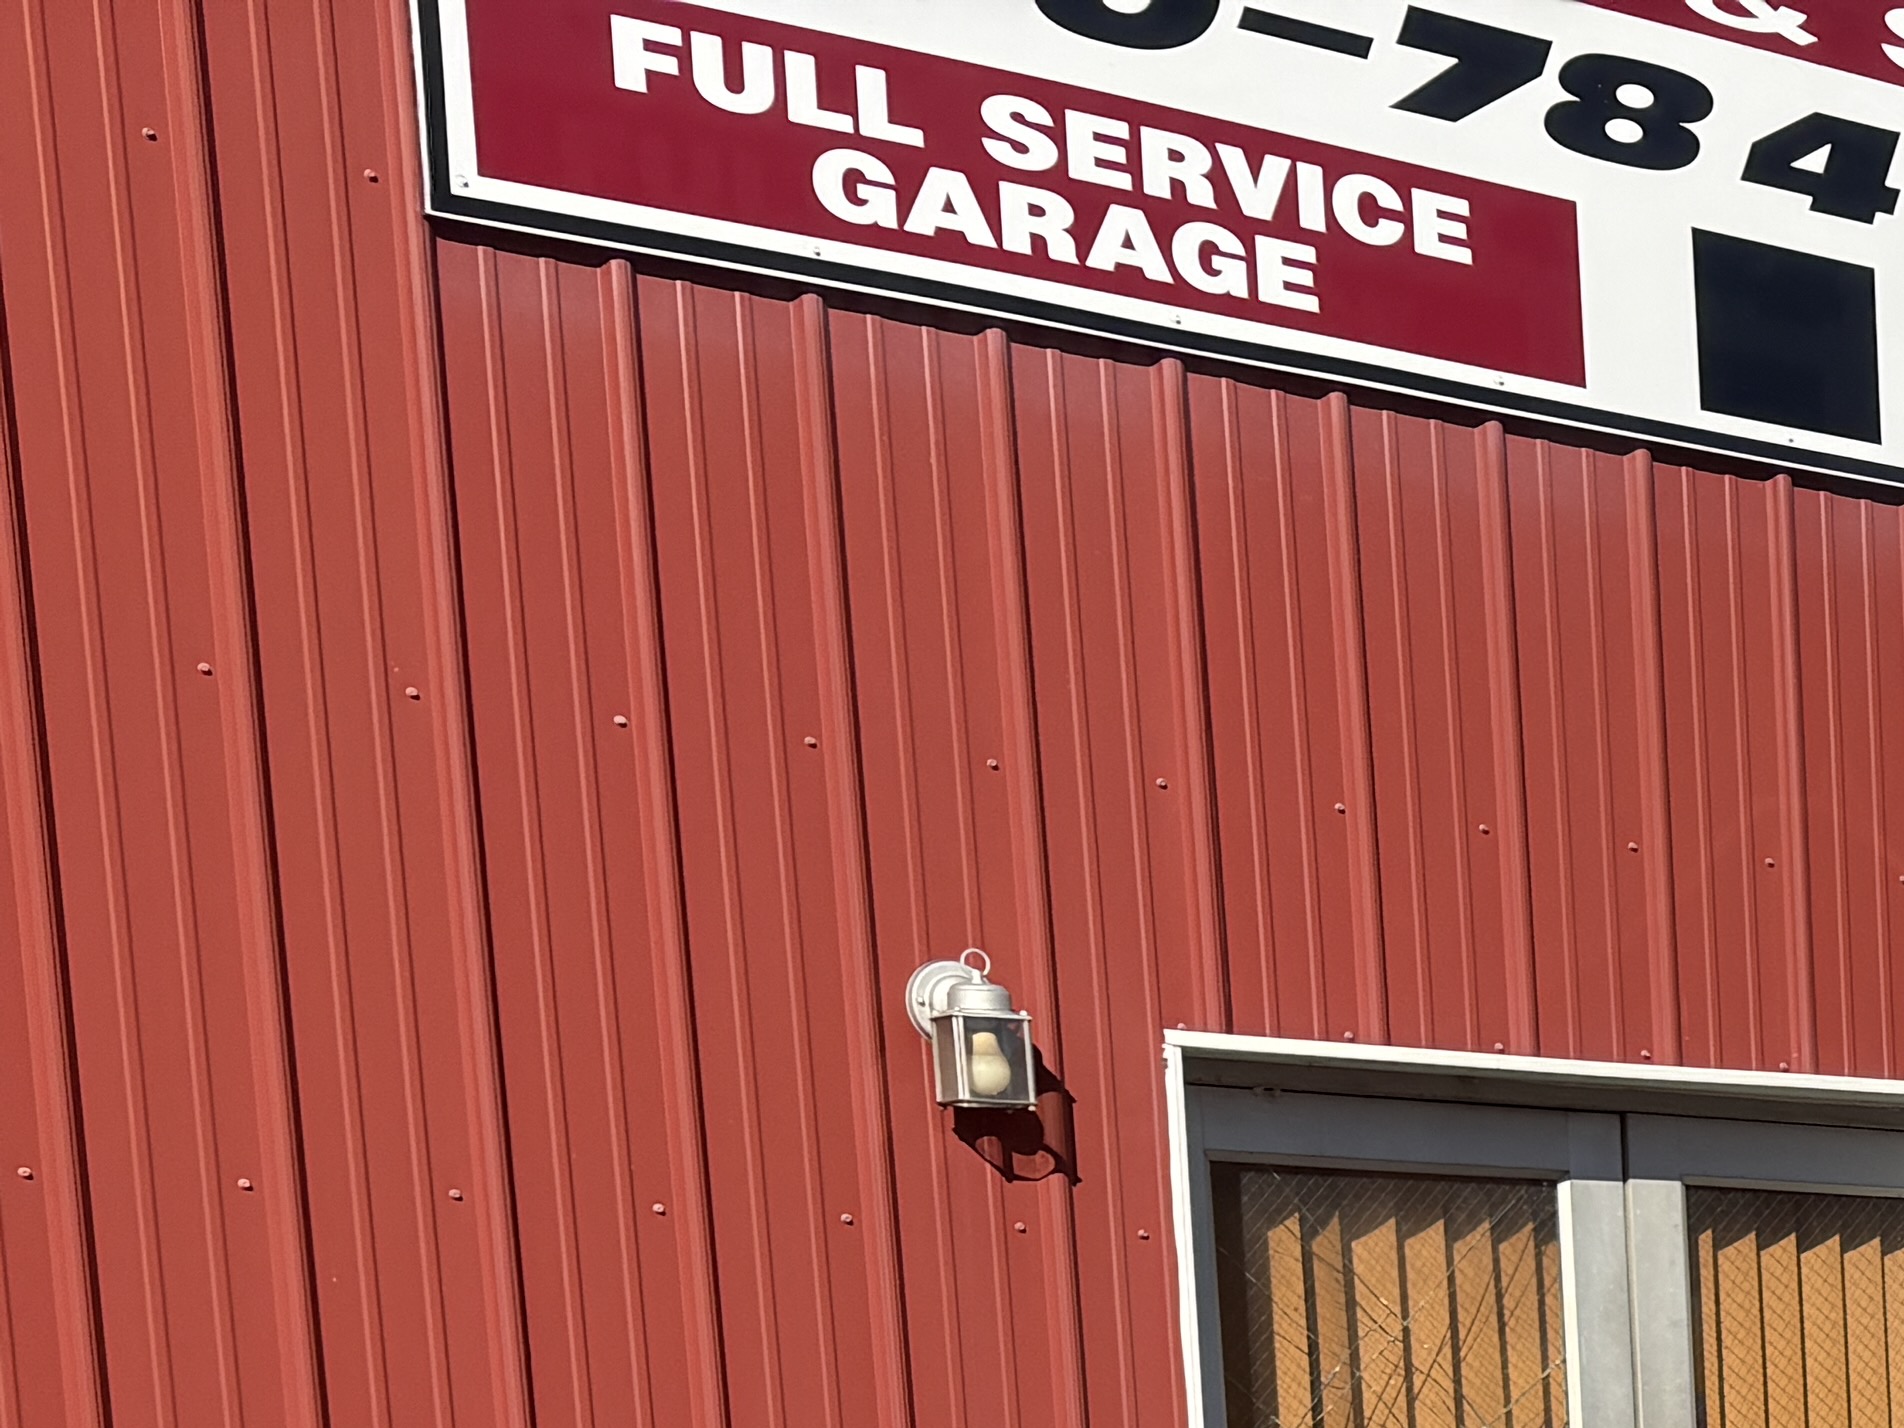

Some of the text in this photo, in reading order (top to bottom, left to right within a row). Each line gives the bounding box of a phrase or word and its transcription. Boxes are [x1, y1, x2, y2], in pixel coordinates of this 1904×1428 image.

[609, 13, 1473, 266] FULL SERVICE
[811, 147, 1321, 314] GARAGE
